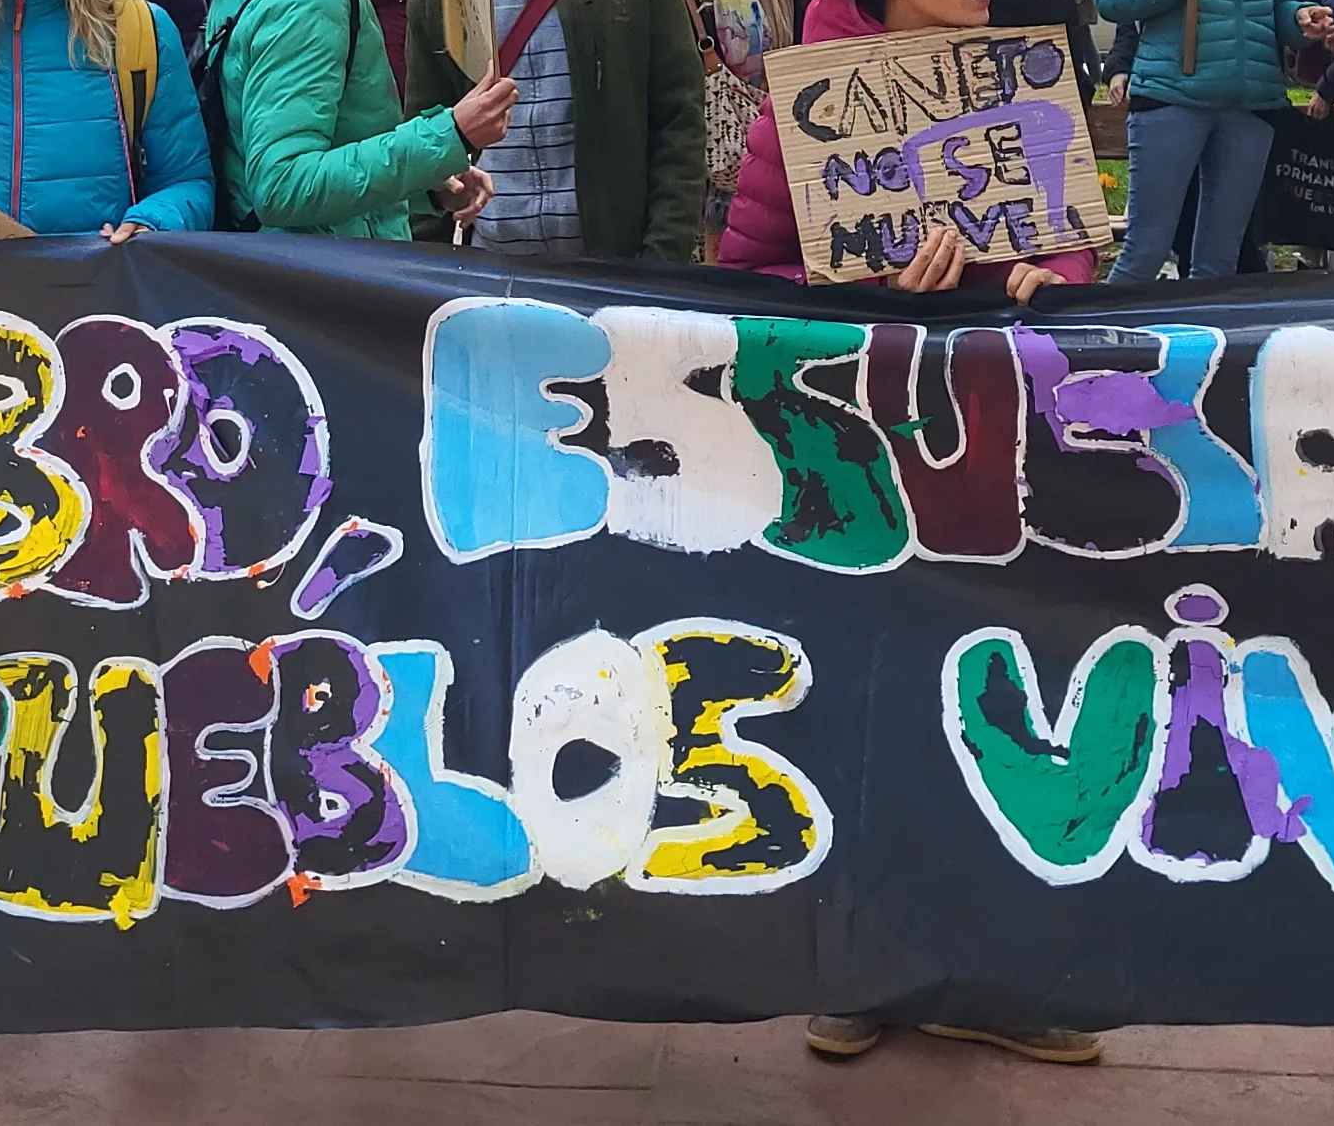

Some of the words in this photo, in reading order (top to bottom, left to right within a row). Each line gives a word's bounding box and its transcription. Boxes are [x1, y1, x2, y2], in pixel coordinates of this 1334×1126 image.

[792, 36, 1066, 143] CANETO
[821, 146, 911, 201] NO
[941, 122, 1032, 201] SE
